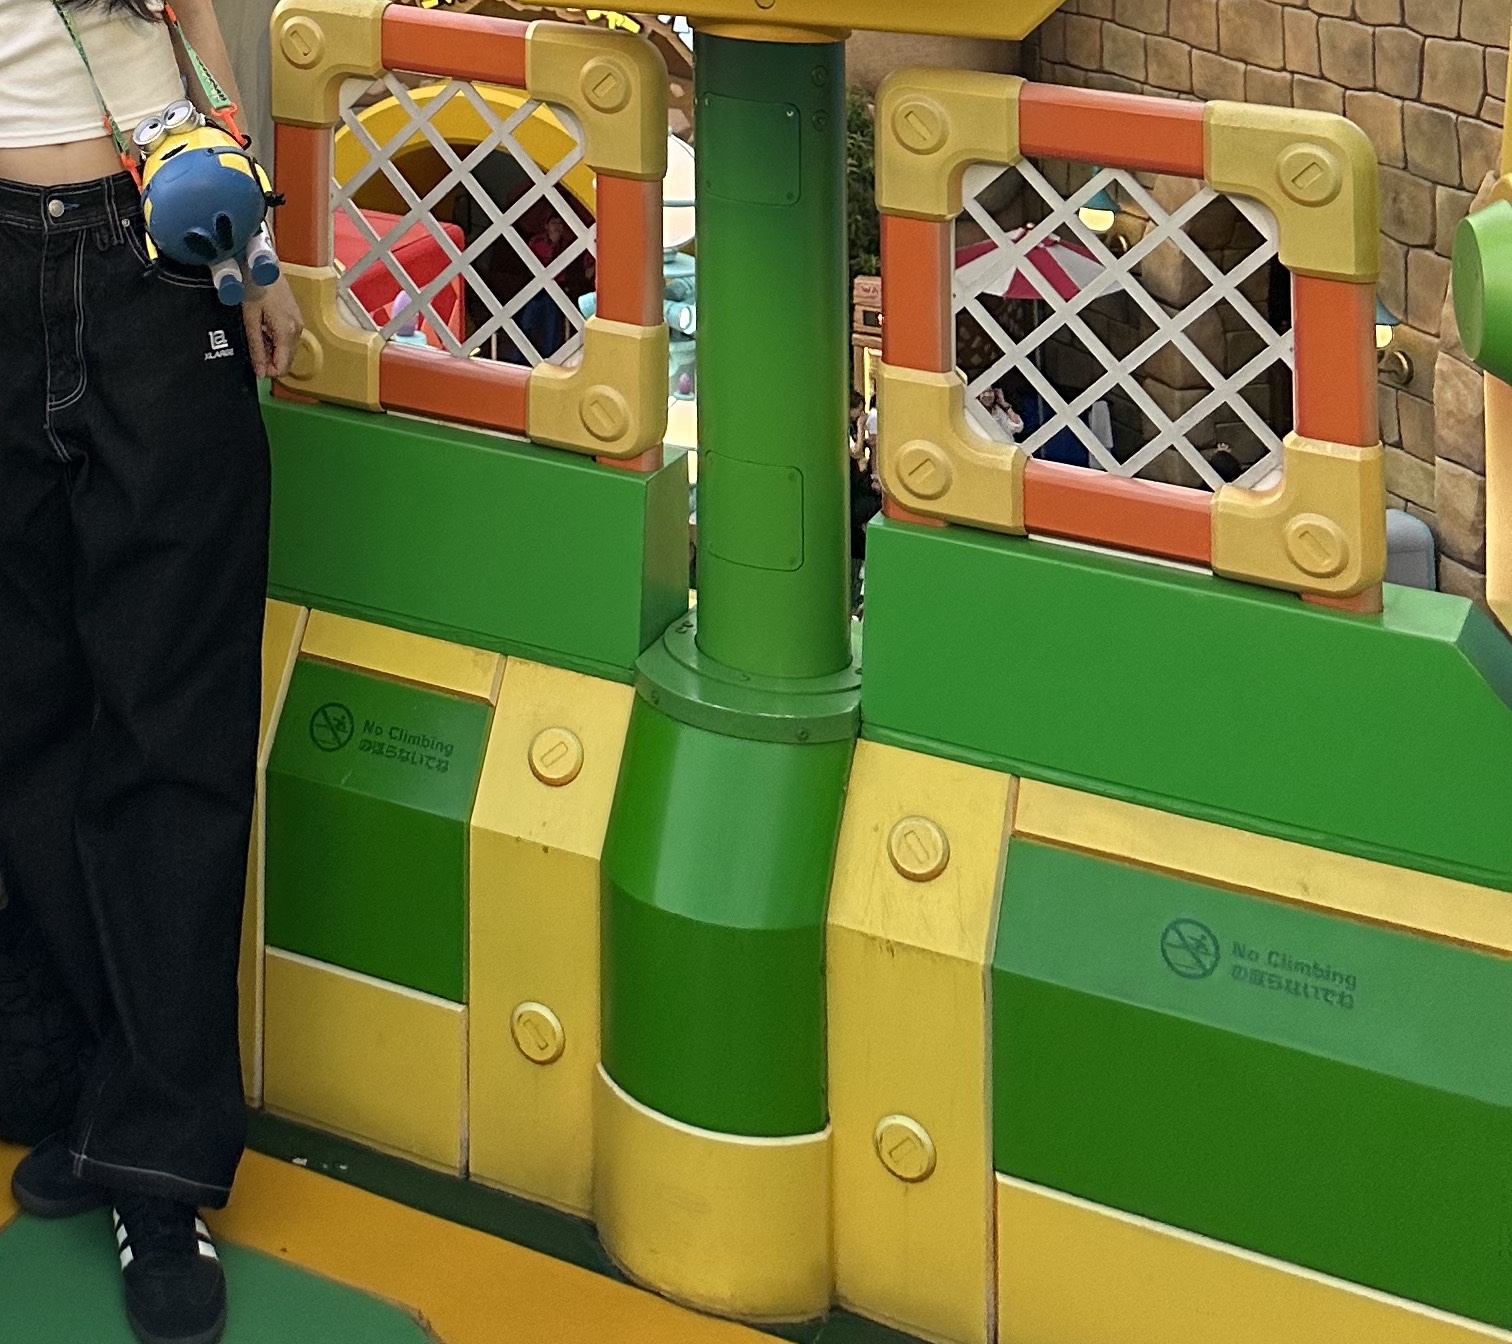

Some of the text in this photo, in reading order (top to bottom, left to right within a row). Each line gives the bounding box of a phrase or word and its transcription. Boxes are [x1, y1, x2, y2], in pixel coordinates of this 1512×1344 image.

[363, 719, 455, 758] No Climbing
[1232, 941, 1357, 992] No Climbing
